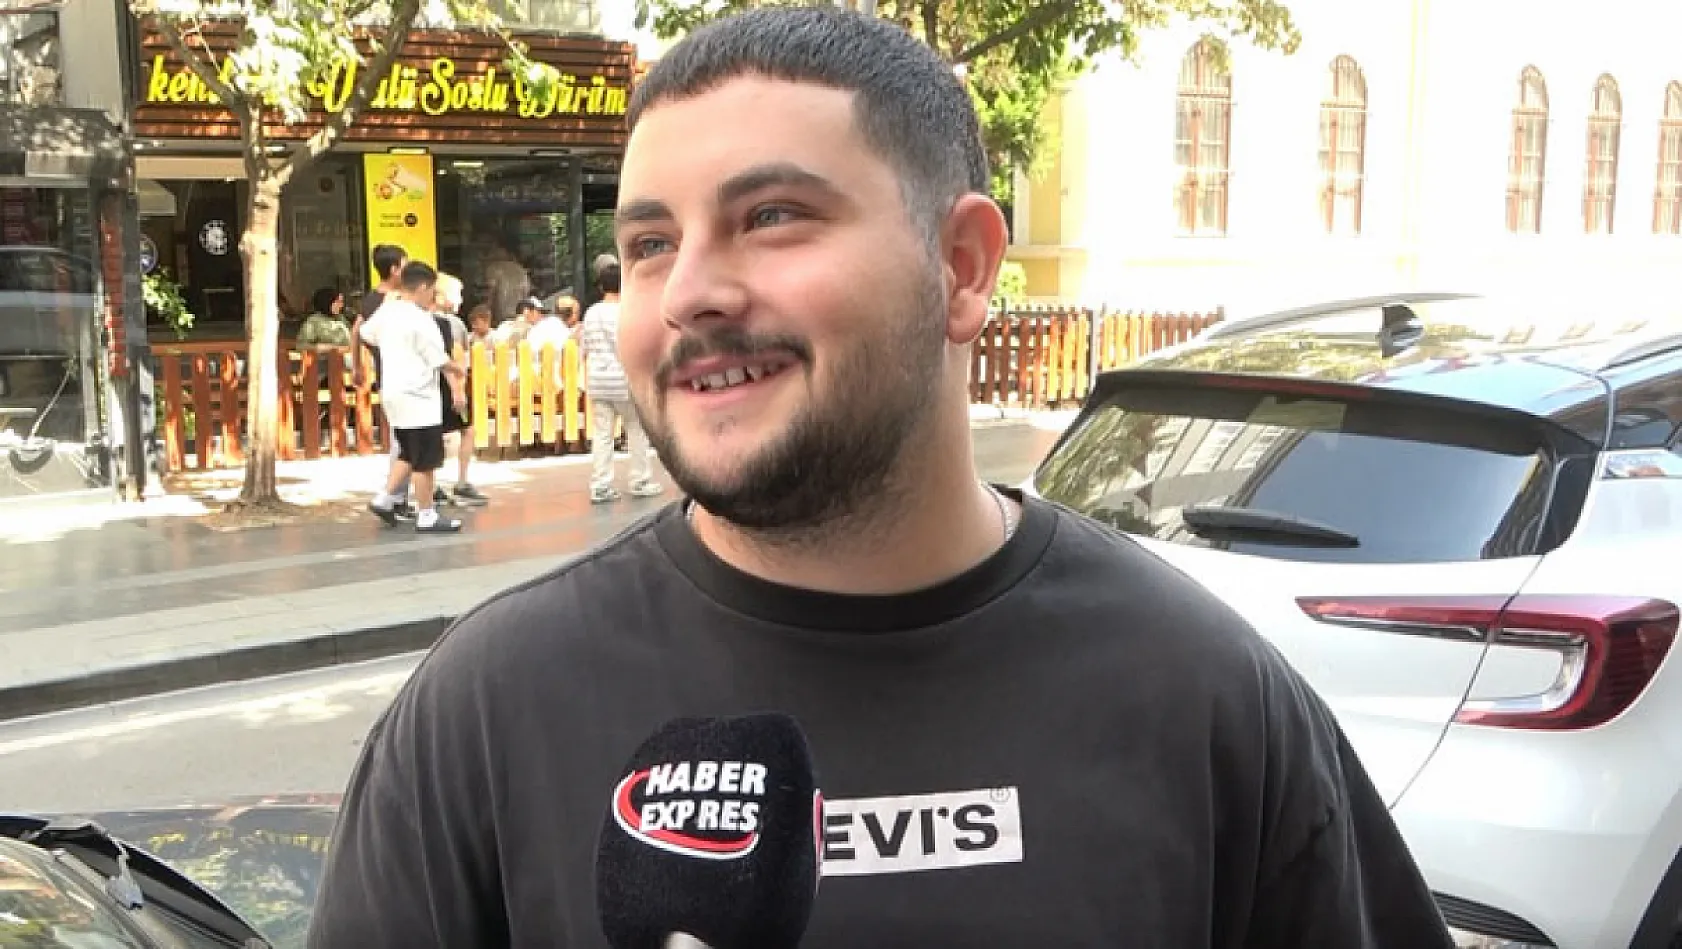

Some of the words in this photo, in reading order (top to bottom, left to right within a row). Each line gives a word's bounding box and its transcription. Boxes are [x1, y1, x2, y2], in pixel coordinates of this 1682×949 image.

[421, 57, 509, 115] Soslu
[645, 760, 768, 796] HABER
[639, 799, 760, 832] EXPRES
[822, 804, 998, 860] EVI'S
